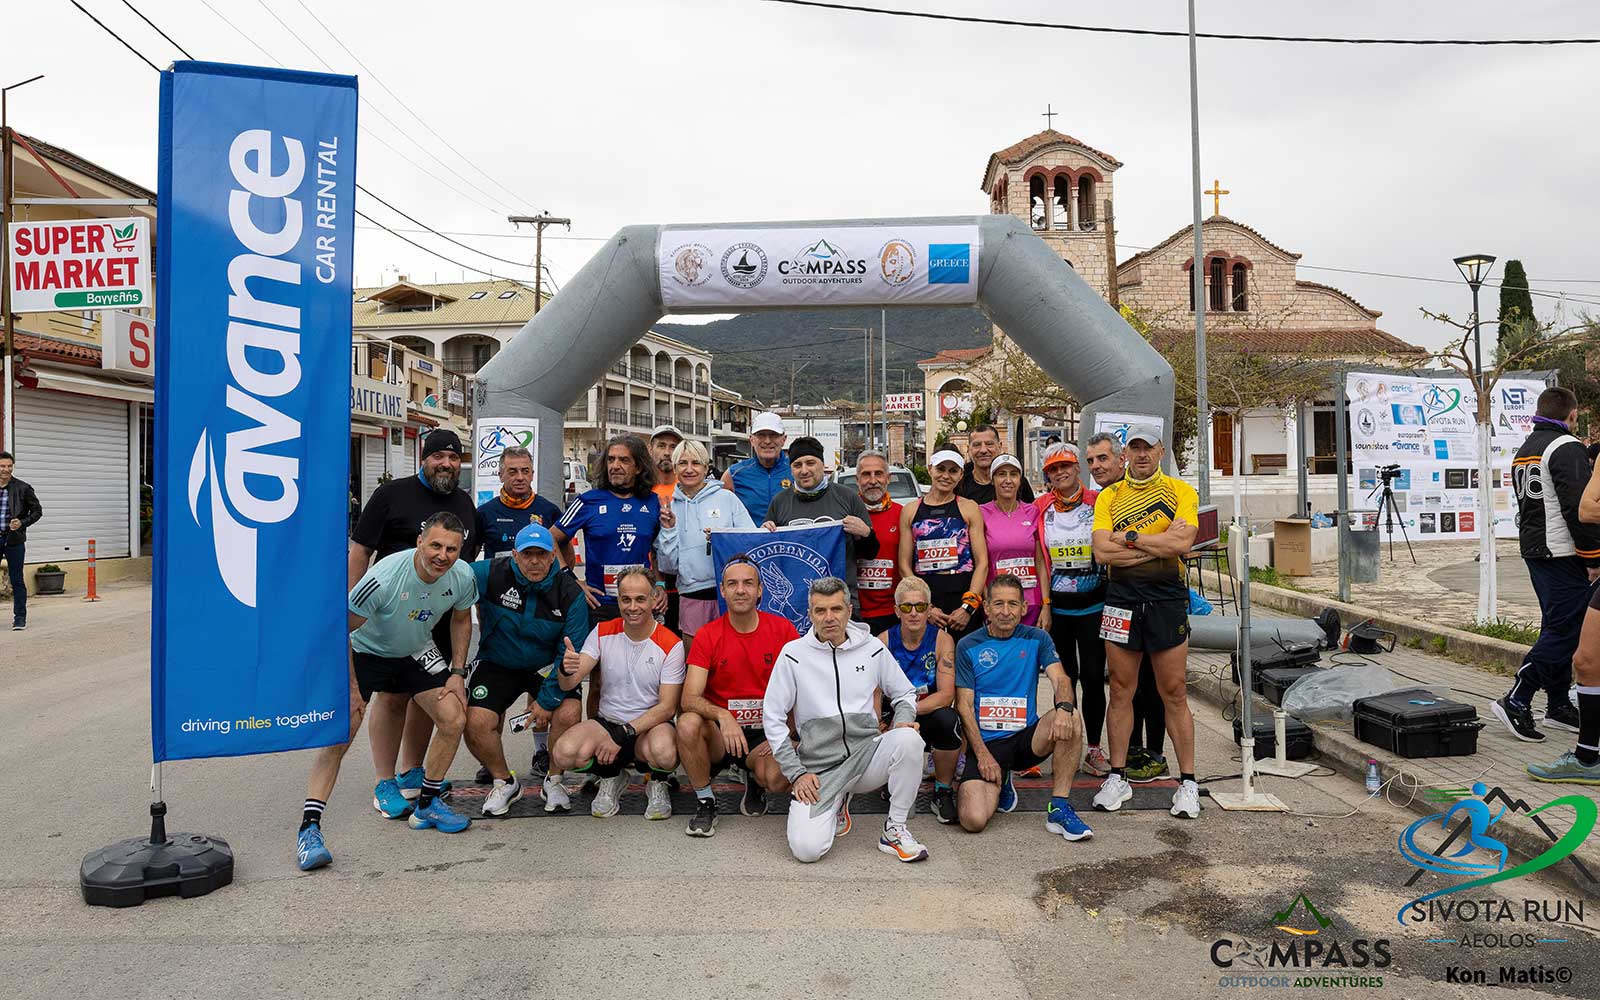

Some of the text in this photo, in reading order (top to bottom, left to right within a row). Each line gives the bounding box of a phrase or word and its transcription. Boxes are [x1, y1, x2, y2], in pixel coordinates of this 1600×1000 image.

[315, 136, 338, 284] CAR RENTAL
[14, 223, 105, 256] SUPER
[778, 259, 867, 275] COMPASS
[929, 258, 969, 267] GREECE
[14, 257, 140, 291] MARKET
[86, 292, 139, 304] Βαγγελής
[224, 129, 306, 523] avance
[1502, 388, 1527, 404] NET
[748, 544, 805, 562] ΡΟΜΕΩΝ
[924, 548, 950, 559] 2072
[1057, 547, 1083, 557] 5134
[861, 568, 887, 577] 2064
[420, 648, 442, 666] 200
[988, 707, 1017, 718] 2021
[181, 708, 335, 734] driving miles together
